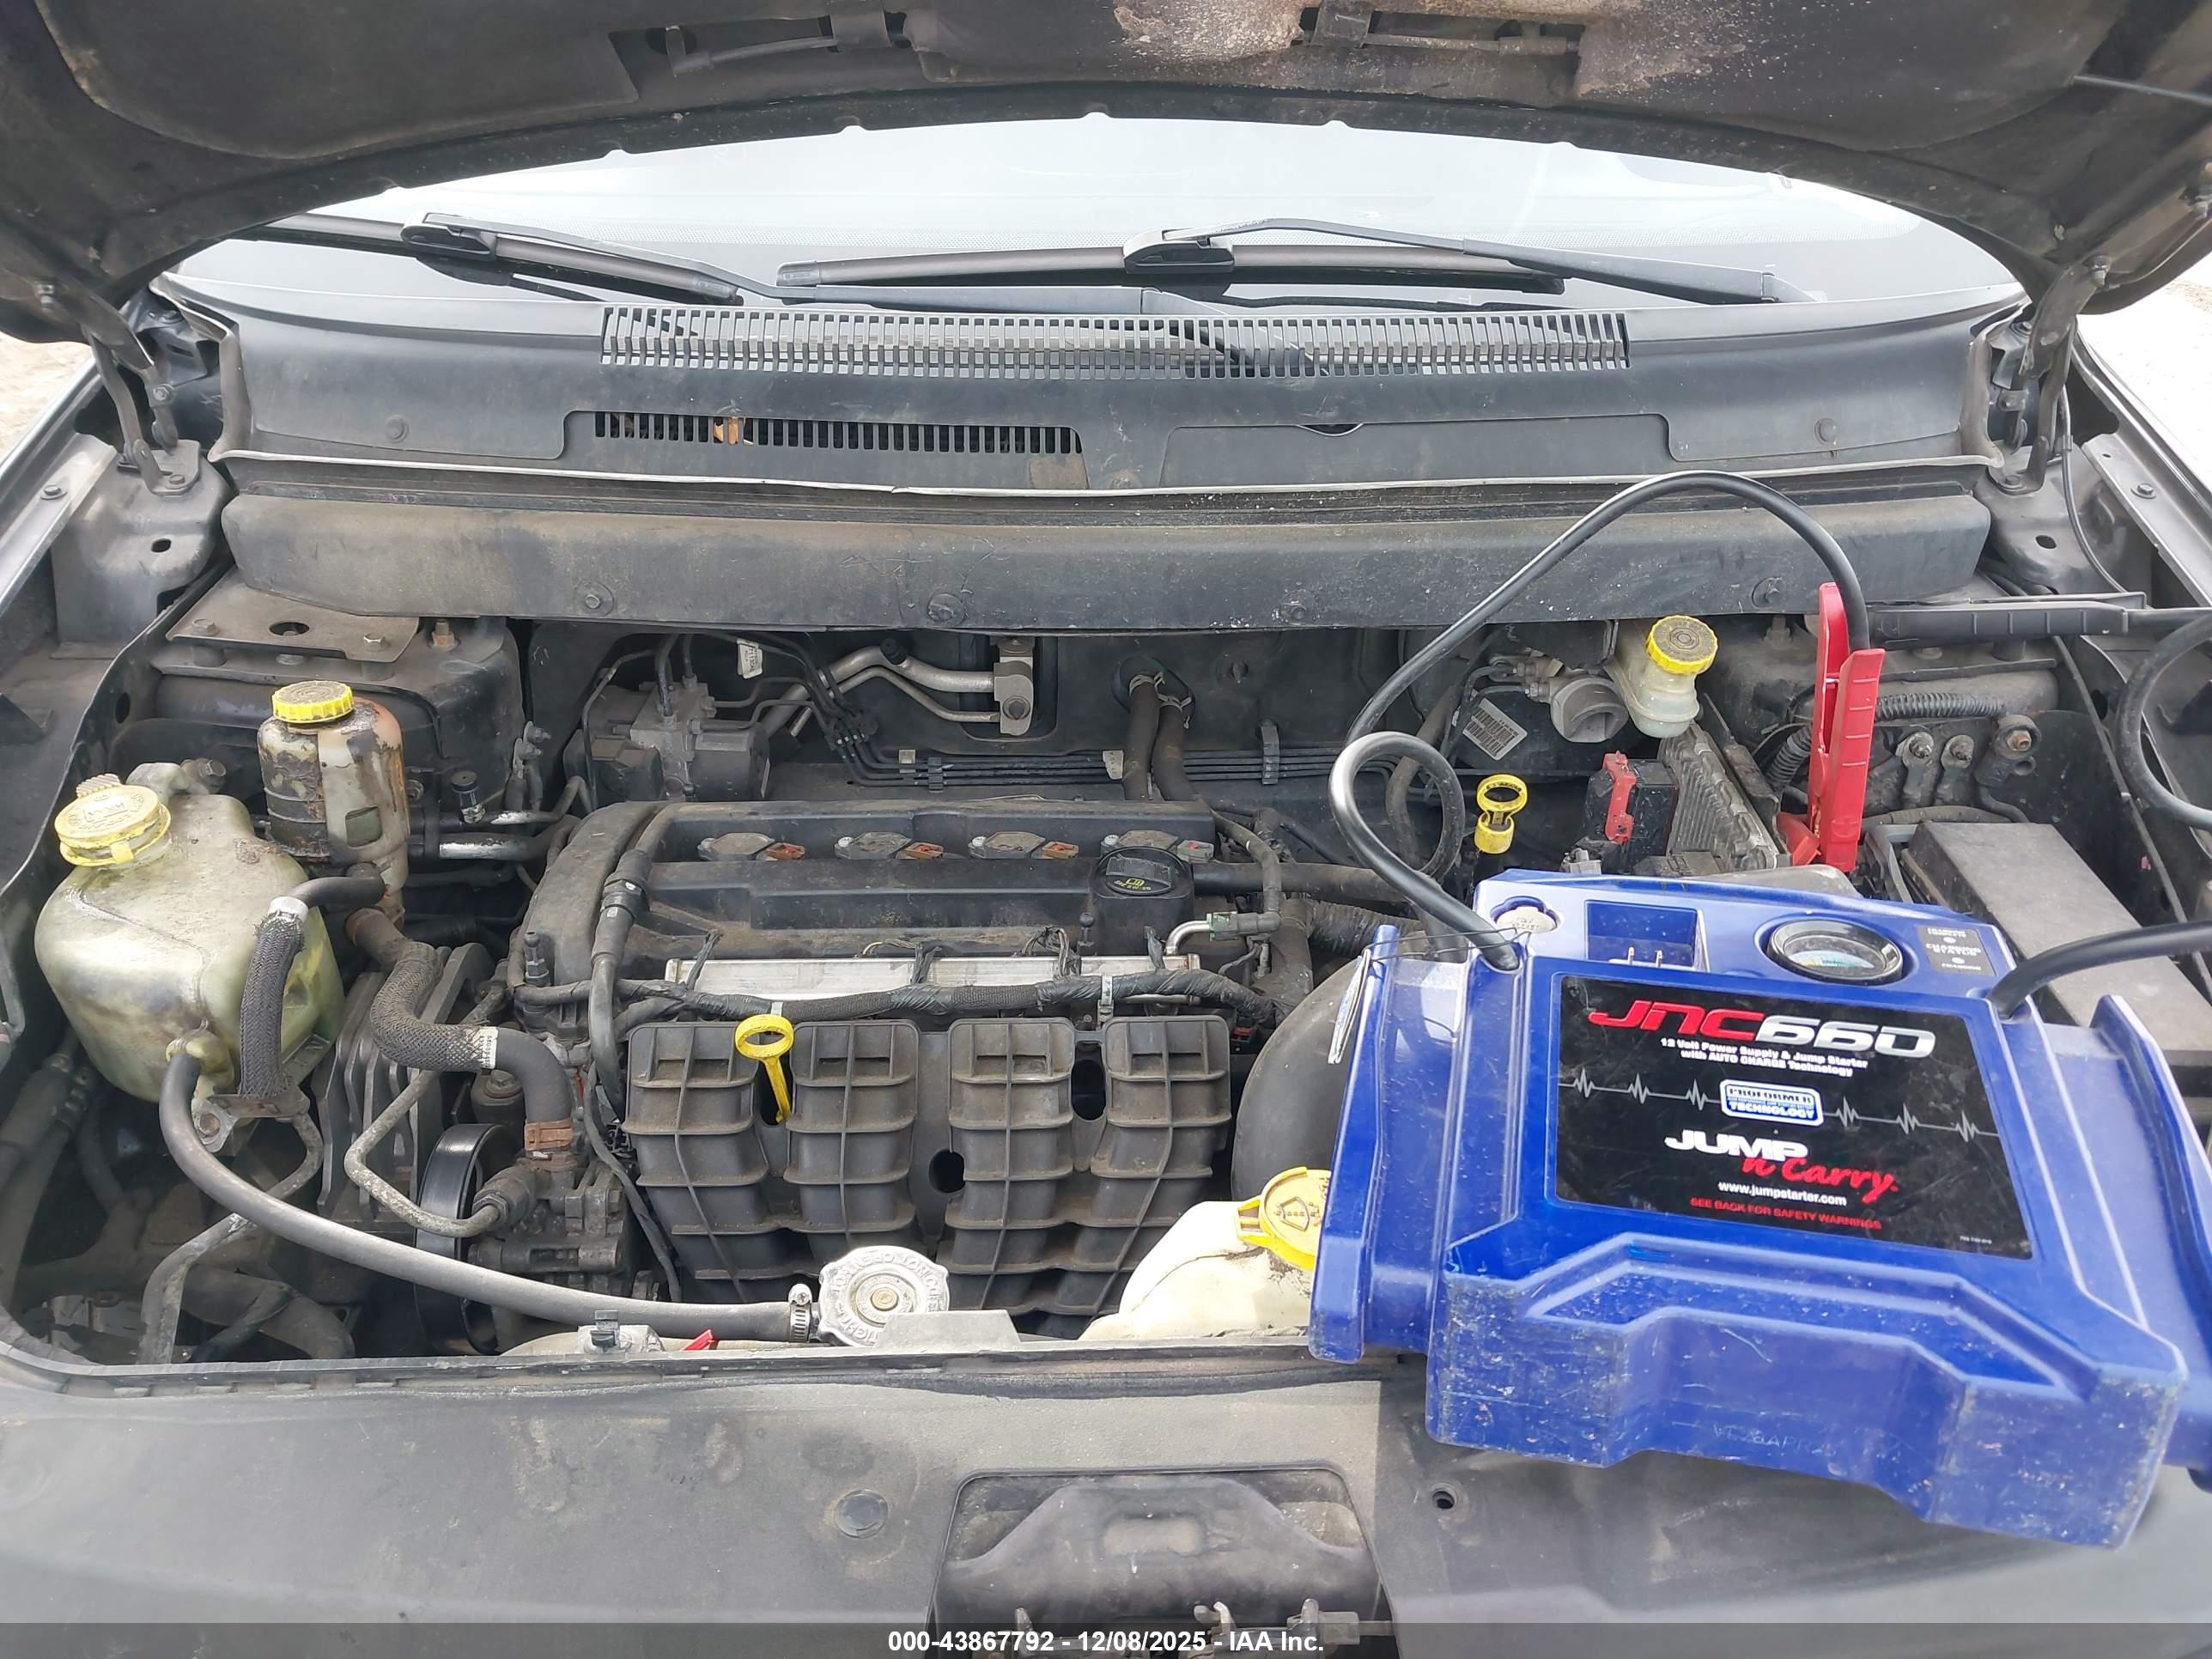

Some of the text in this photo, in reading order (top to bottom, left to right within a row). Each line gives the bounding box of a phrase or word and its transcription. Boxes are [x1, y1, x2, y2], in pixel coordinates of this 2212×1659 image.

[1661, 1037, 1869, 1069] 12 Volt Power Supply & Jump Starter
[1680, 1049, 1853, 1078] with AUTO CHARGE Technology
[1729, 1100, 1815, 1120] TECHNOLOGY
[1664, 1129, 1809, 1162] JUMP
[1718, 1181, 1847, 1206] www.jumpstarter.com
[1781, 1158, 1894, 1205] Carry
[1690, 1197, 1882, 1231] SEE BACK FOR SAFETY WARNINGS
